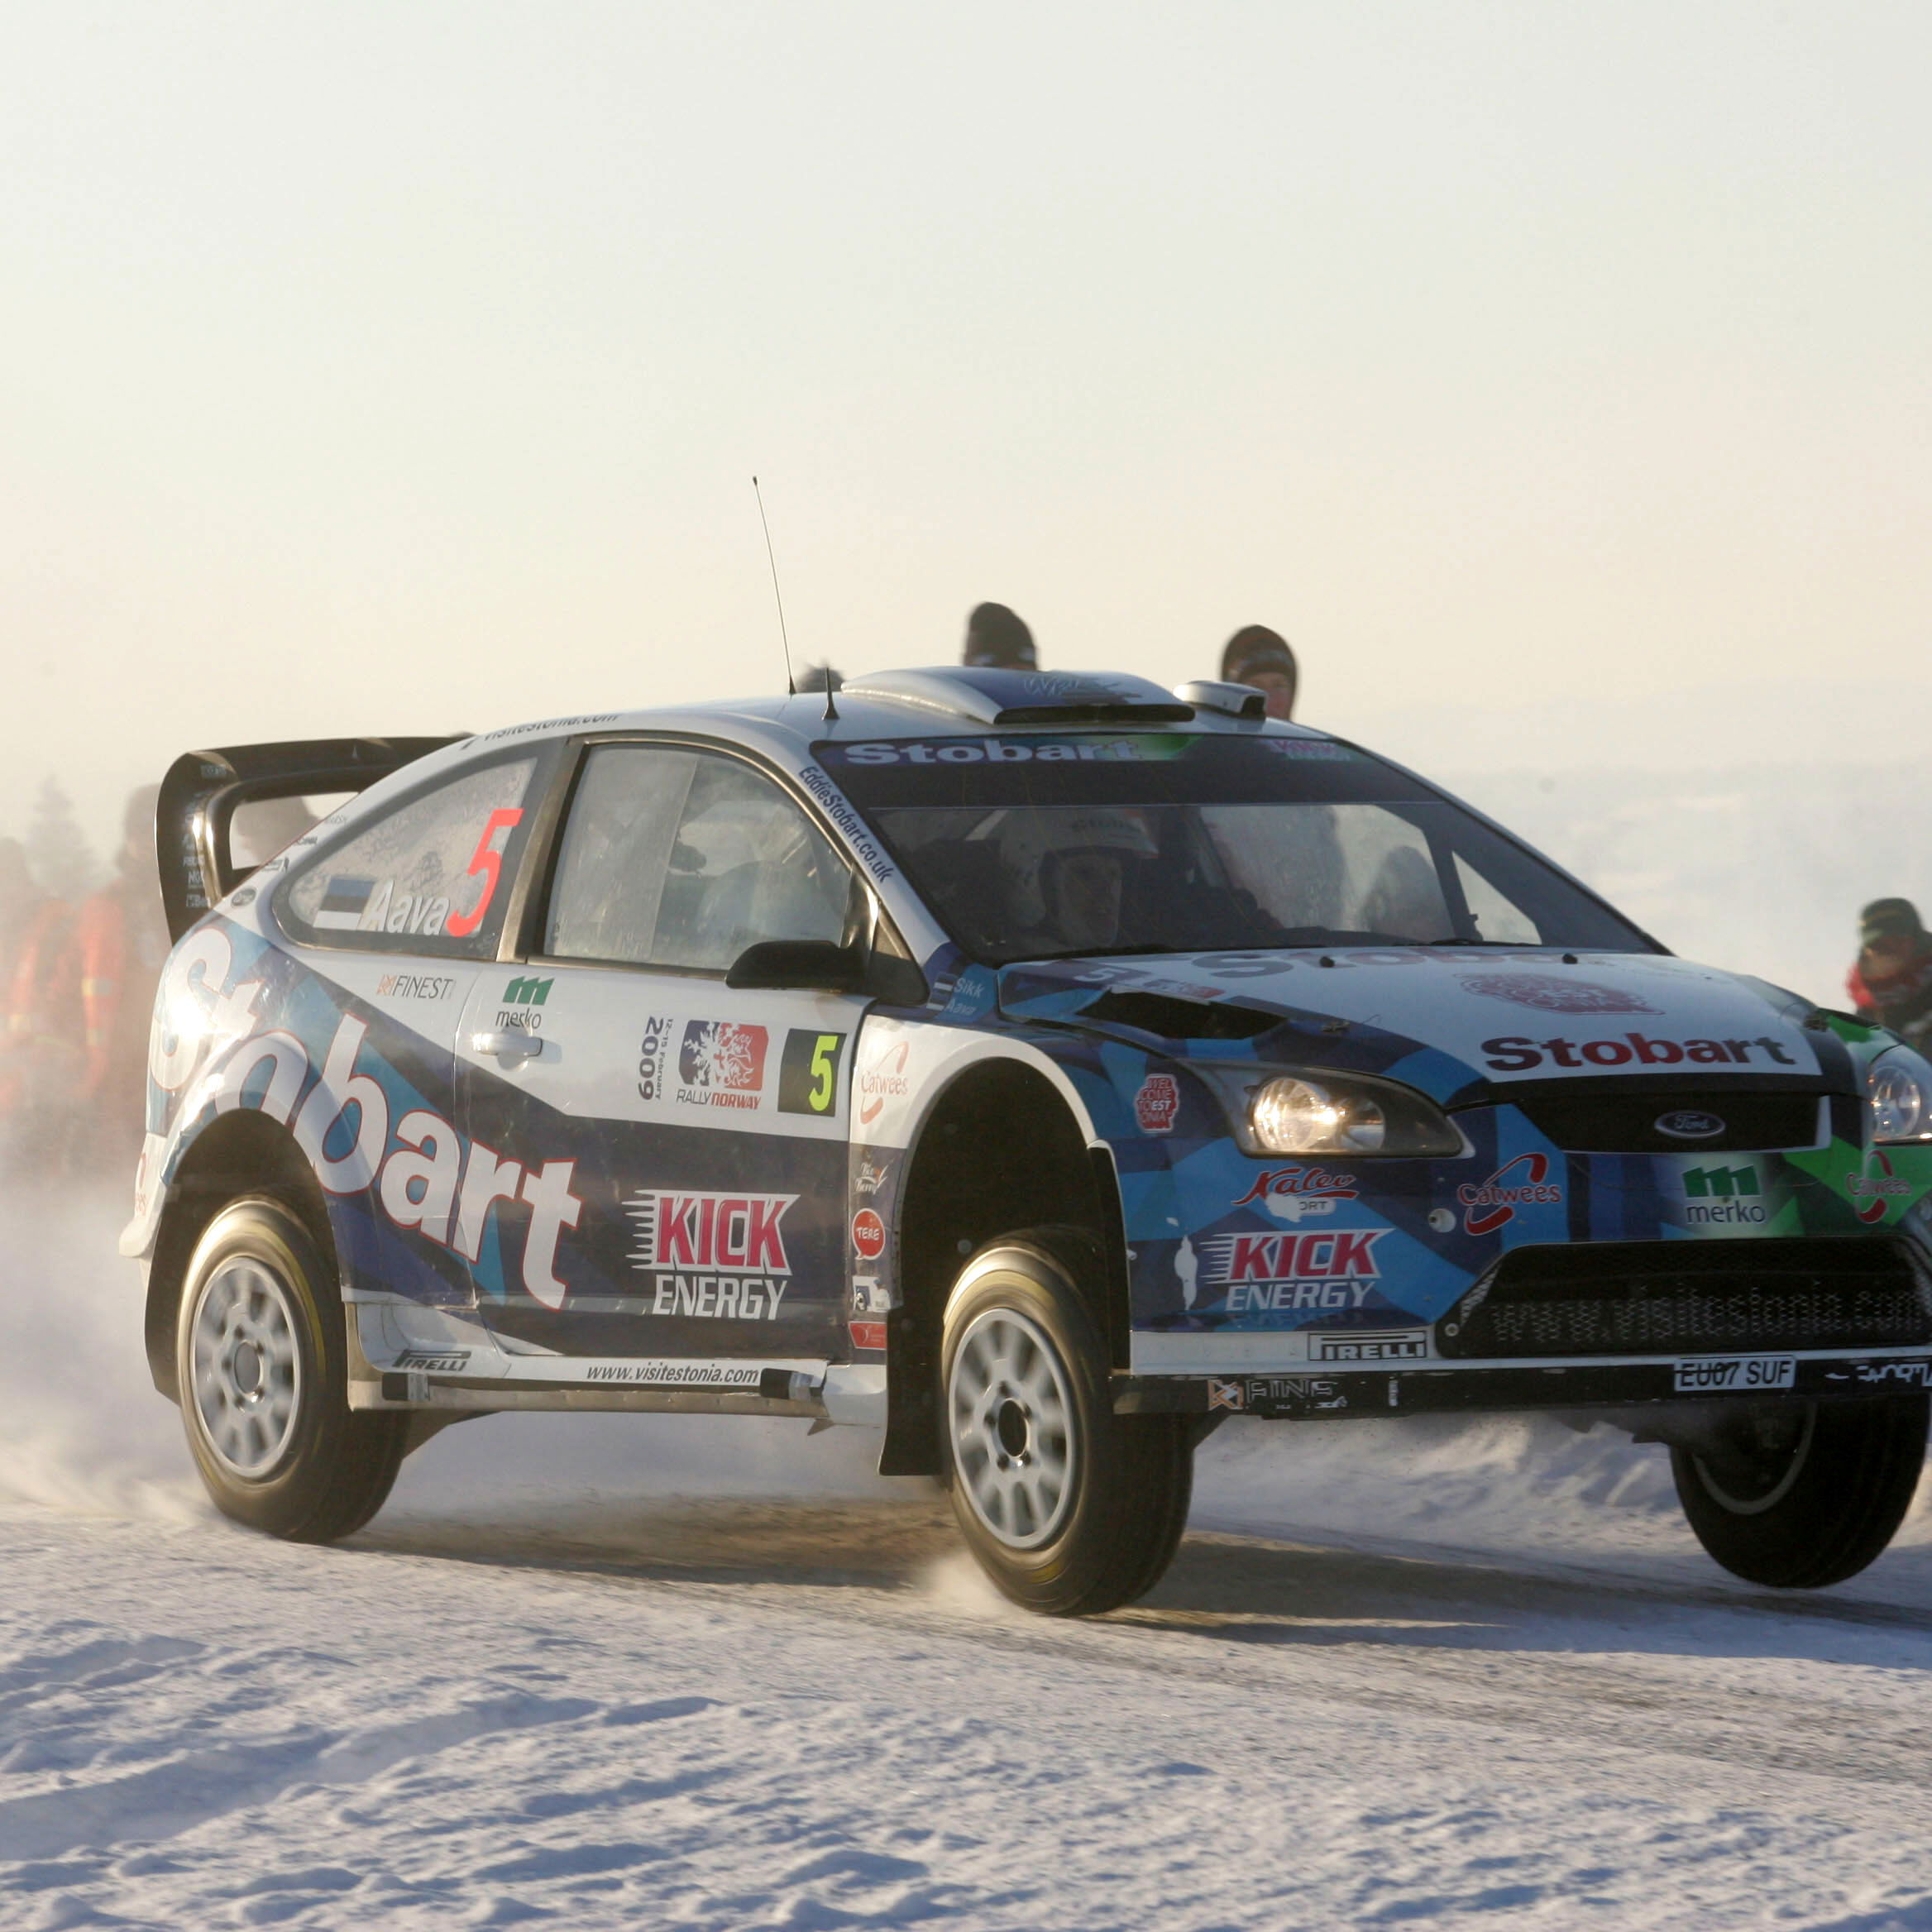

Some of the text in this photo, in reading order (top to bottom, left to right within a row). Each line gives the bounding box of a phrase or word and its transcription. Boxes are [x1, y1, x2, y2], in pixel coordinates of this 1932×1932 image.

[844, 739, 1143, 765] Stobart
[798, 766, 894, 883] EddieStobart.co.uk
[447, 807, 525, 938] 5
[356, 879, 451, 936] Aava
[495, 1007, 542, 1030] merko
[638, 1016, 663, 1101] 2009
[1480, 1032, 1796, 1072] Stobart
[808, 1035, 839, 1112] 5
[149, 927, 583, 1313] Stobart
[1457, 1182, 1562, 1208] Catwees
[1686, 1199, 1767, 1225] merko
[651, 1192, 792, 1274] KICK
[856, 1227, 880, 1241] TERE
[1227, 1230, 1385, 1282] KICK
[652, 1274, 788, 1321] ENERGY
[1224, 1281, 1377, 1312] ENERGY
[391, 1349, 471, 1372] PIRELLI
[1308, 1331, 1427, 1361] PIRELLI
[586, 1361, 759, 1384] www.visitestonia.com
[1746, 1360, 1792, 1384] SUF
